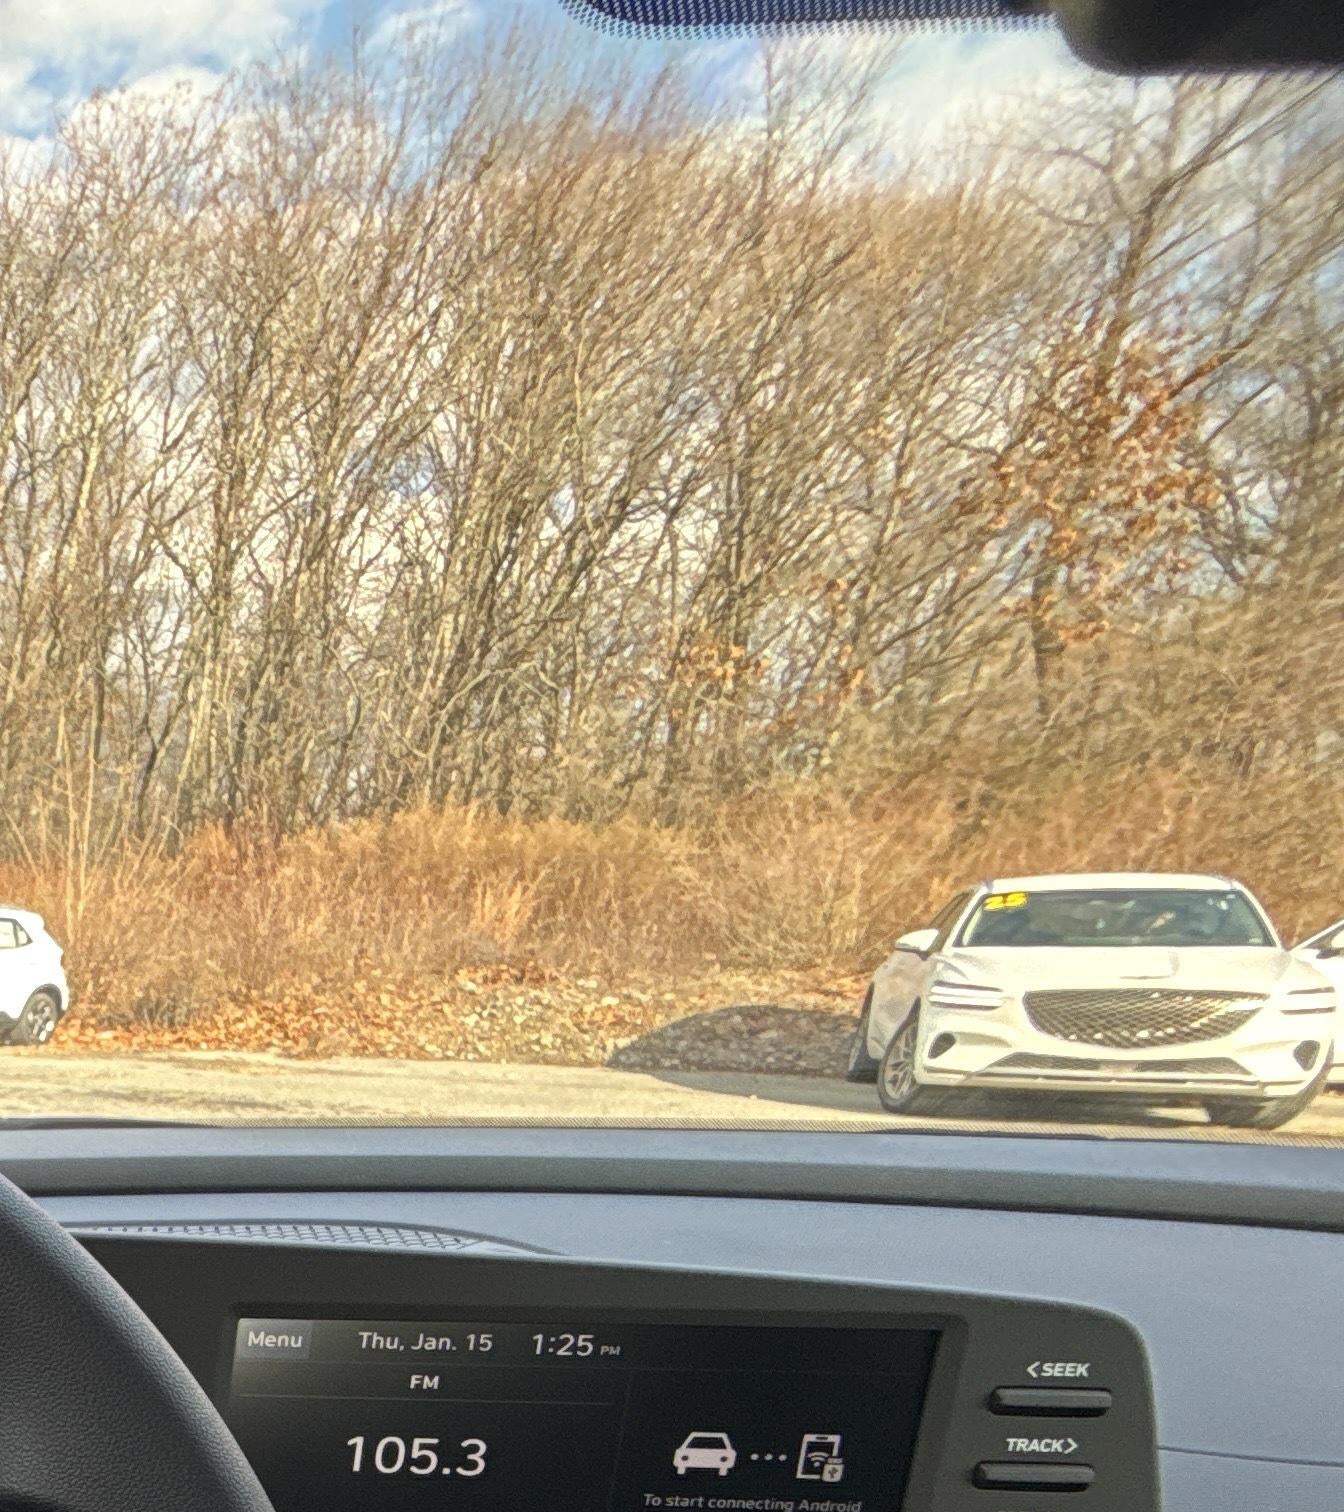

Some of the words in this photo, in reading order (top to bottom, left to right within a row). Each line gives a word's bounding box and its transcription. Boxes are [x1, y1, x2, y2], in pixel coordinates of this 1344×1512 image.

[247, 1330, 302, 1348] Menu
[358, 1331, 405, 1351] Thu,
[411, 1333, 457, 1351] Jan.
[466, 1334, 493, 1352] 15
[532, 1333, 594, 1356] 1:25
[600, 1345, 621, 1356] PM
[1040, 1363, 1090, 1378] SEEK
[409, 1374, 440, 1390] FM
[1005, 1438, 1065, 1453] TRACK
[346, 1435, 488, 1476] 105.3
[643, 1493, 661, 1507] To
[665, 1495, 703, 1508] start
[798, 1498, 862, 1512] Android
